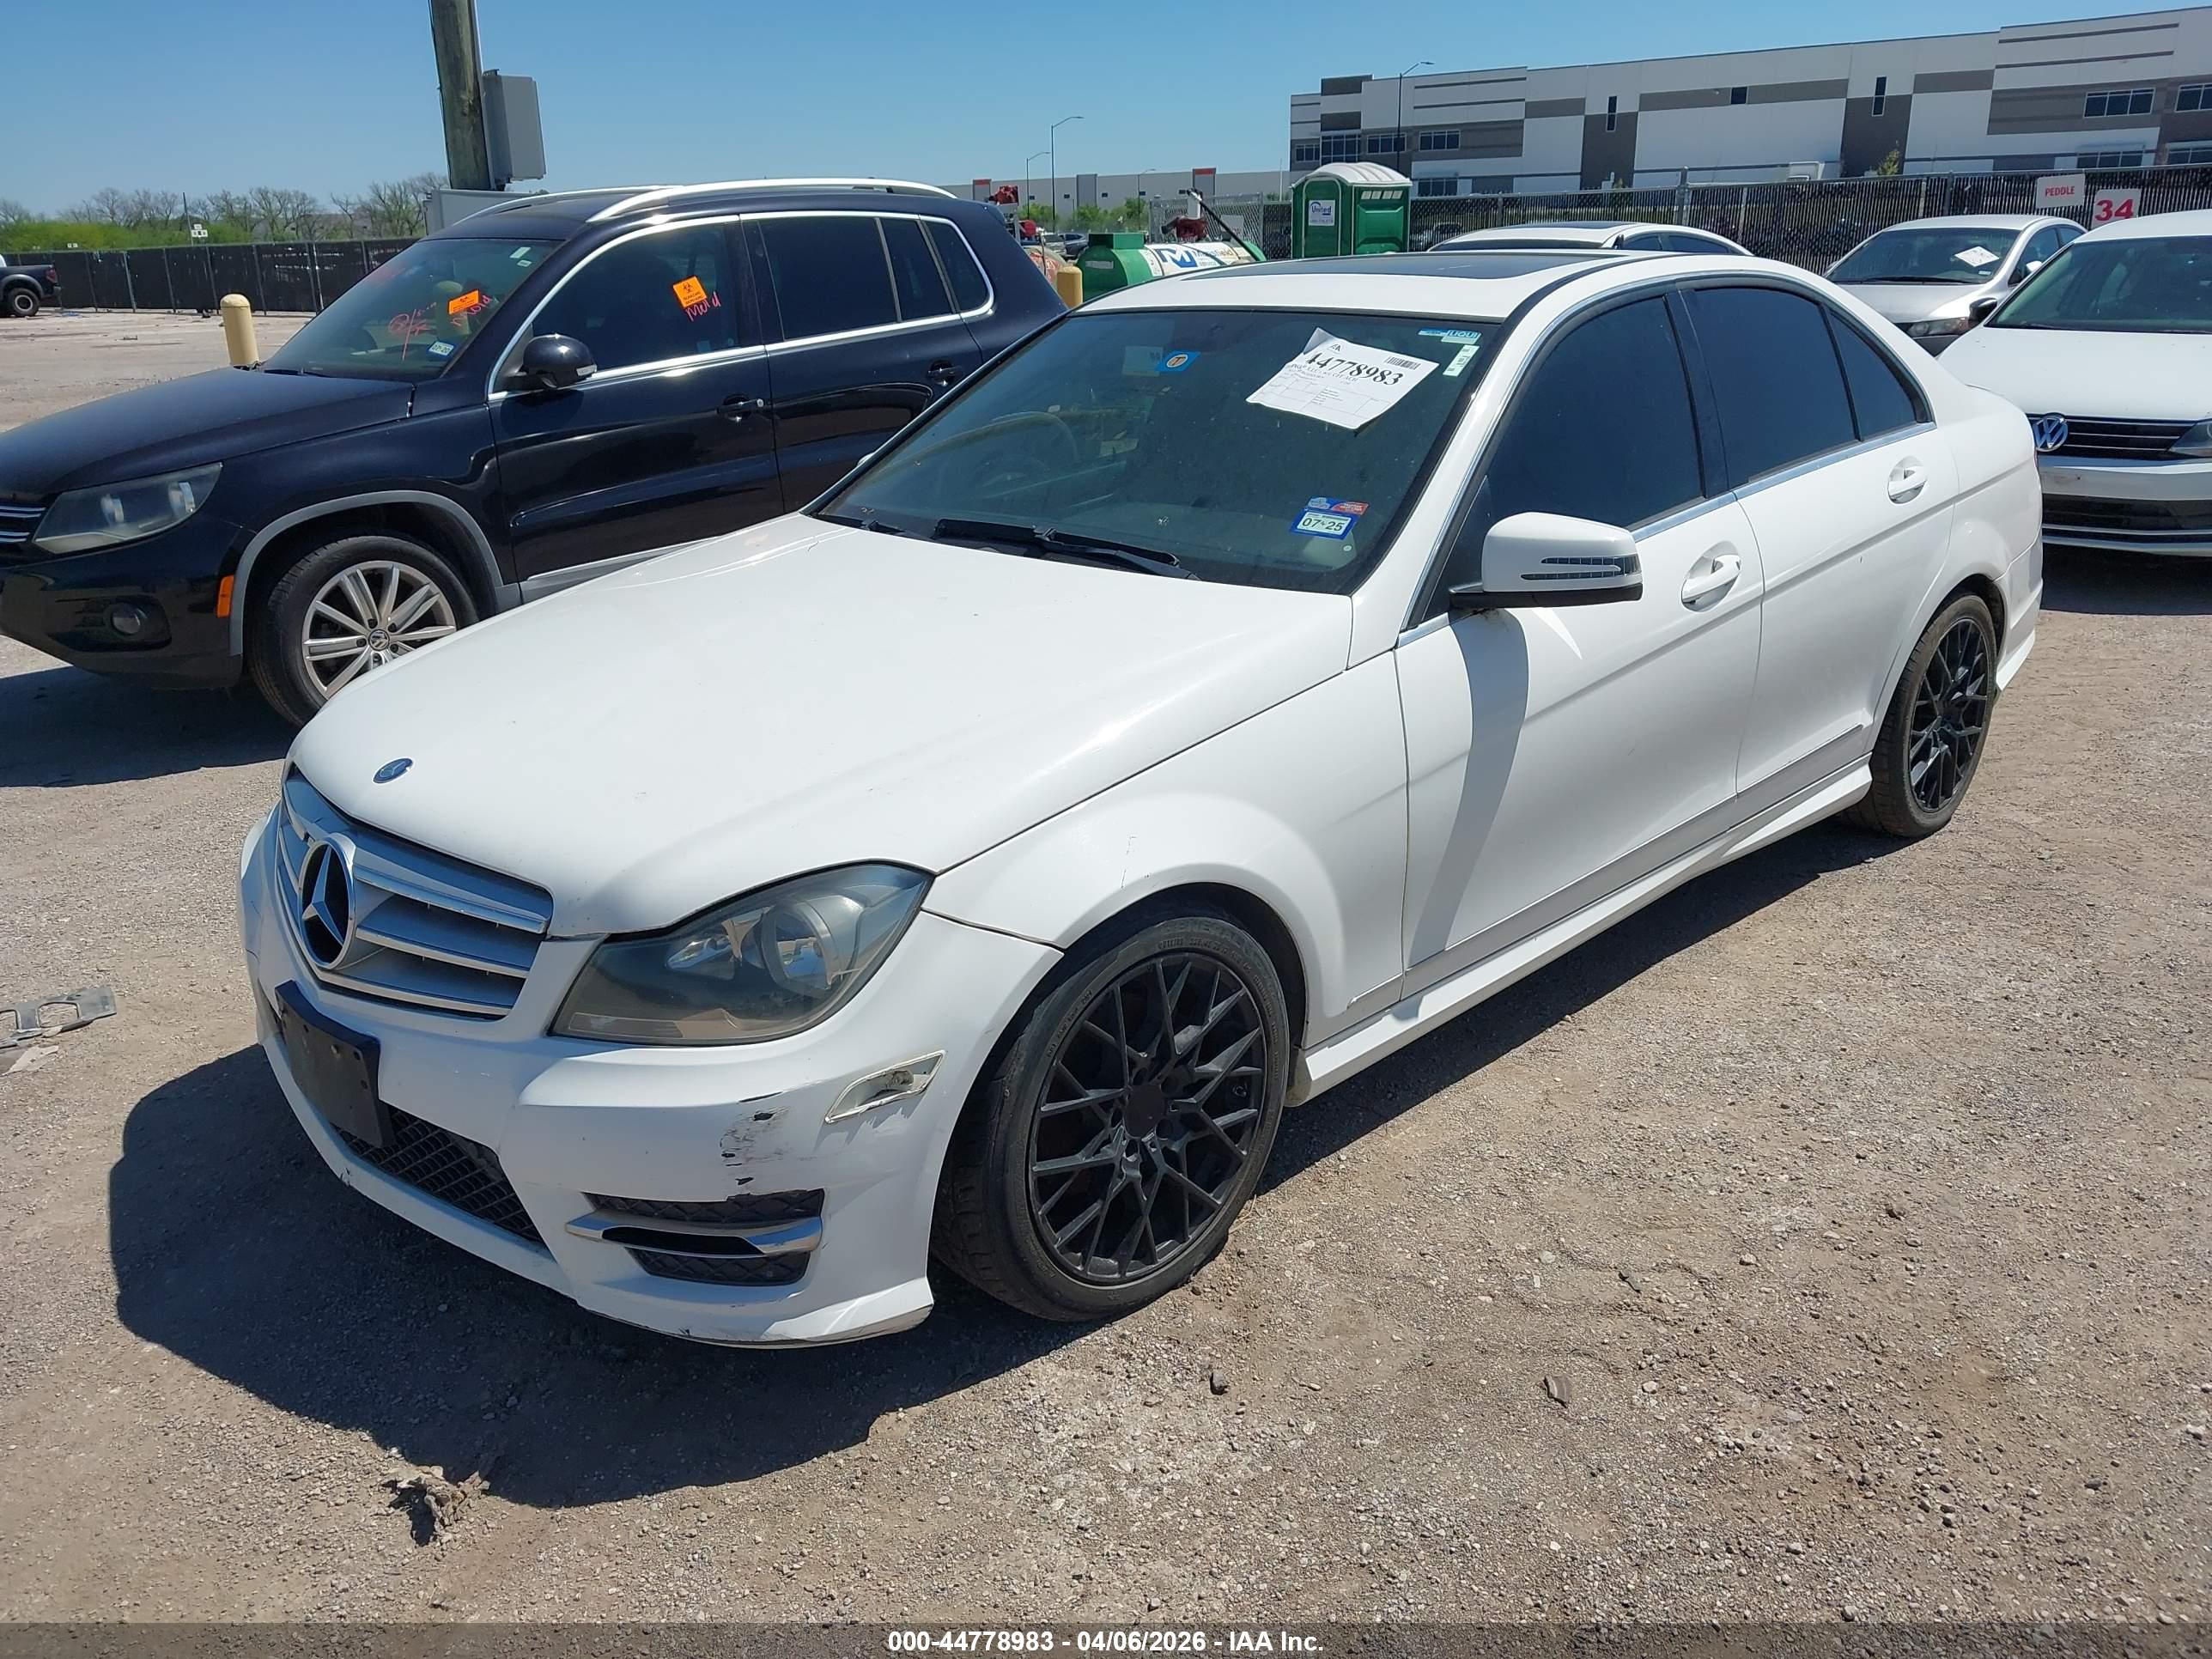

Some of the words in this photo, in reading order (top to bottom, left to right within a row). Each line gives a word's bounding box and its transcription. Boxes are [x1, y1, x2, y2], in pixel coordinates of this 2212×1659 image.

[2045, 185, 2075, 198] PEDDLE
[1311, 205, 1332, 214] United
[2094, 198, 2135, 222] 34
[1304, 352, 1405, 386] 44778983
[1302, 517, 1322, 528] 07
[1325, 520, 1346, 532] 25
